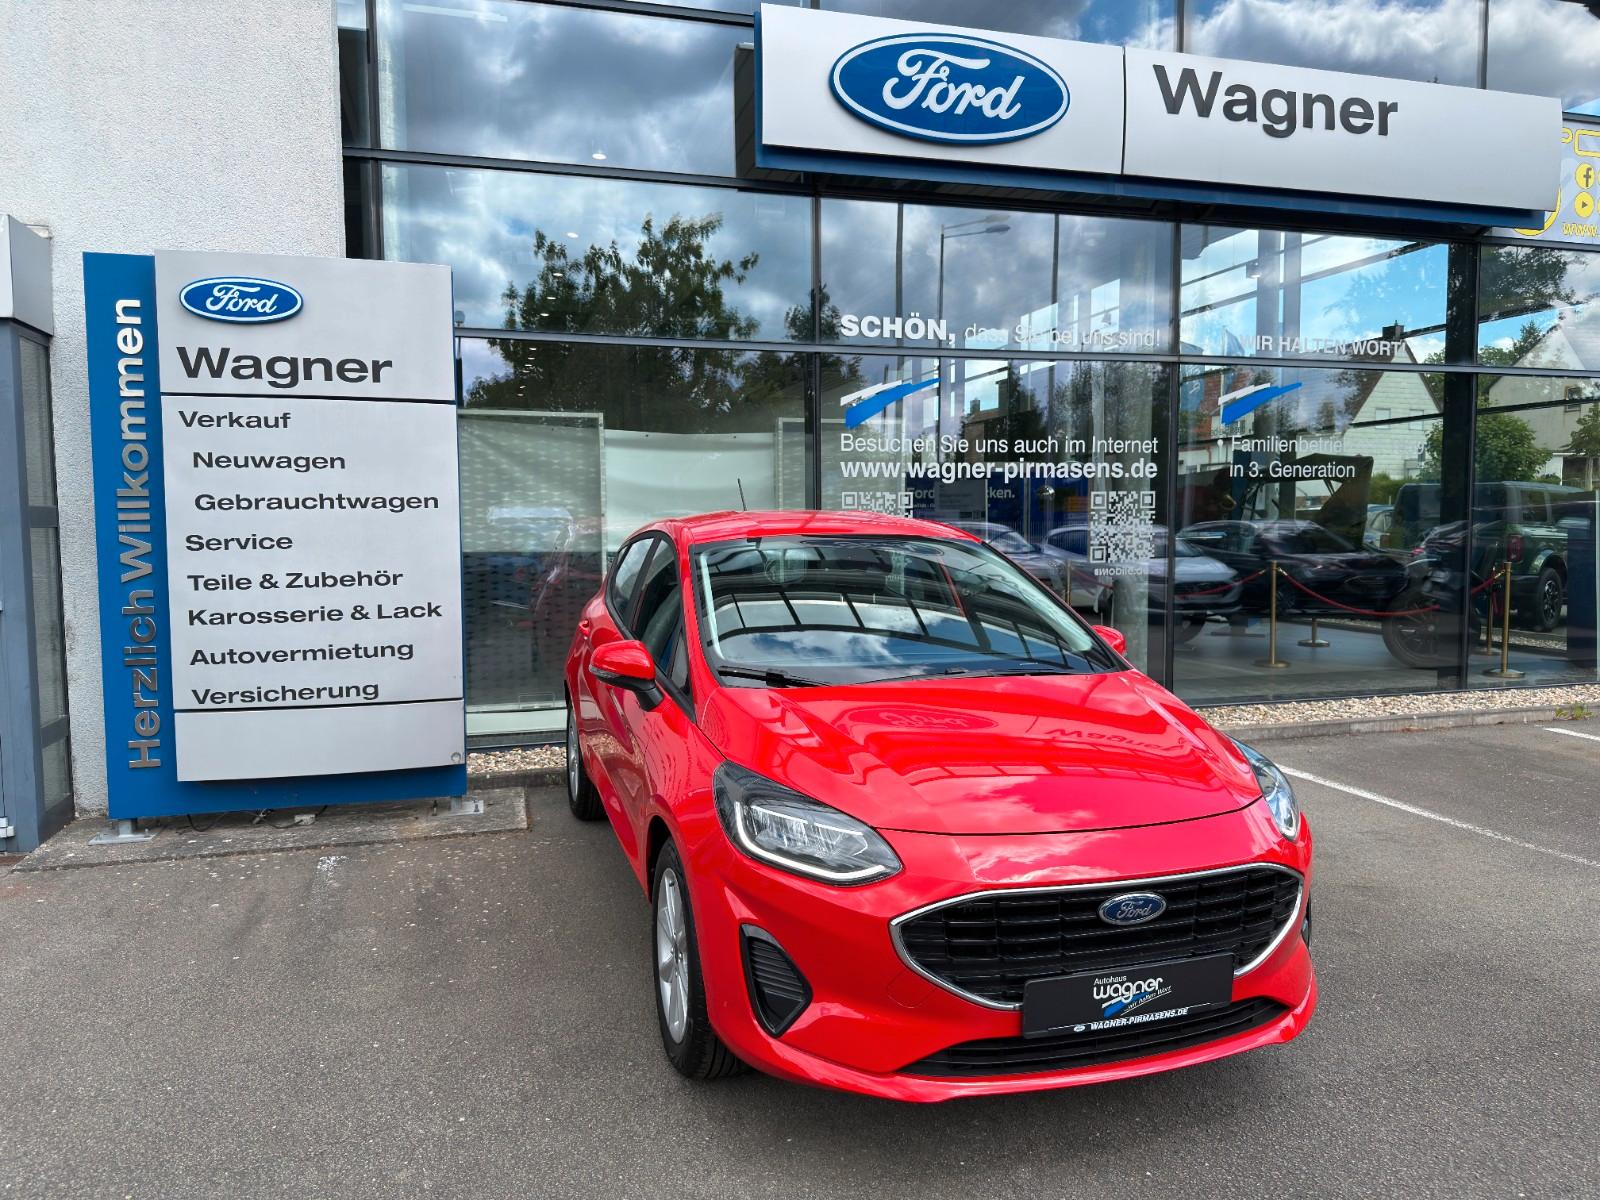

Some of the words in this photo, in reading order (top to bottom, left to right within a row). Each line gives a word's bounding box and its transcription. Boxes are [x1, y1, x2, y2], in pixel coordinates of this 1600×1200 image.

[882, 48, 1024, 120] Ford
[1153, 64, 1398, 137] Wagner
[206, 283, 279, 315] Ford
[840, 311, 956, 345] SCHÖN,
[1118, 328, 1160, 346] sind!
[176, 346, 393, 389] Wagner
[178, 410, 292, 429] Verkauf
[115, 298, 154, 583] Willkommen
[840, 432, 935, 453] Besuchen
[940, 434, 968, 453] Sie
[976, 438, 1008, 453] uns
[1014, 436, 1058, 453] auch
[1064, 436, 1085, 453] im
[1092, 436, 1158, 454] Internet
[1231, 435, 1348, 454] Familienbetrie
[193, 451, 346, 473] Neuwagen
[840, 457, 1158, 484] www.wagner-pirmasens.de
[1229, 463, 1244, 478] in
[1249, 461, 1264, 478] 3.
[1269, 460, 1356, 478] Generation
[194, 493, 439, 514] Gebrauchtwagen
[185, 533, 293, 552] Service
[187, 573, 252, 592] Teile
[259, 573, 279, 590] &
[285, 569, 403, 589] Zubehör
[188, 605, 344, 626] Karosserie
[350, 604, 370, 620] &
[377, 602, 442, 620] Lack
[189, 641, 414, 666] Autovermietung
[121, 589, 161, 770] Herzlich
[191, 681, 379, 705] Versicherung
[1115, 899, 1153, 920] Ford
[1093, 975, 1127, 986] Autohaus
[1093, 977, 1164, 1004] wagner
[1090, 1007, 1190, 1031] WAGNER-PIRMASENS.DE
